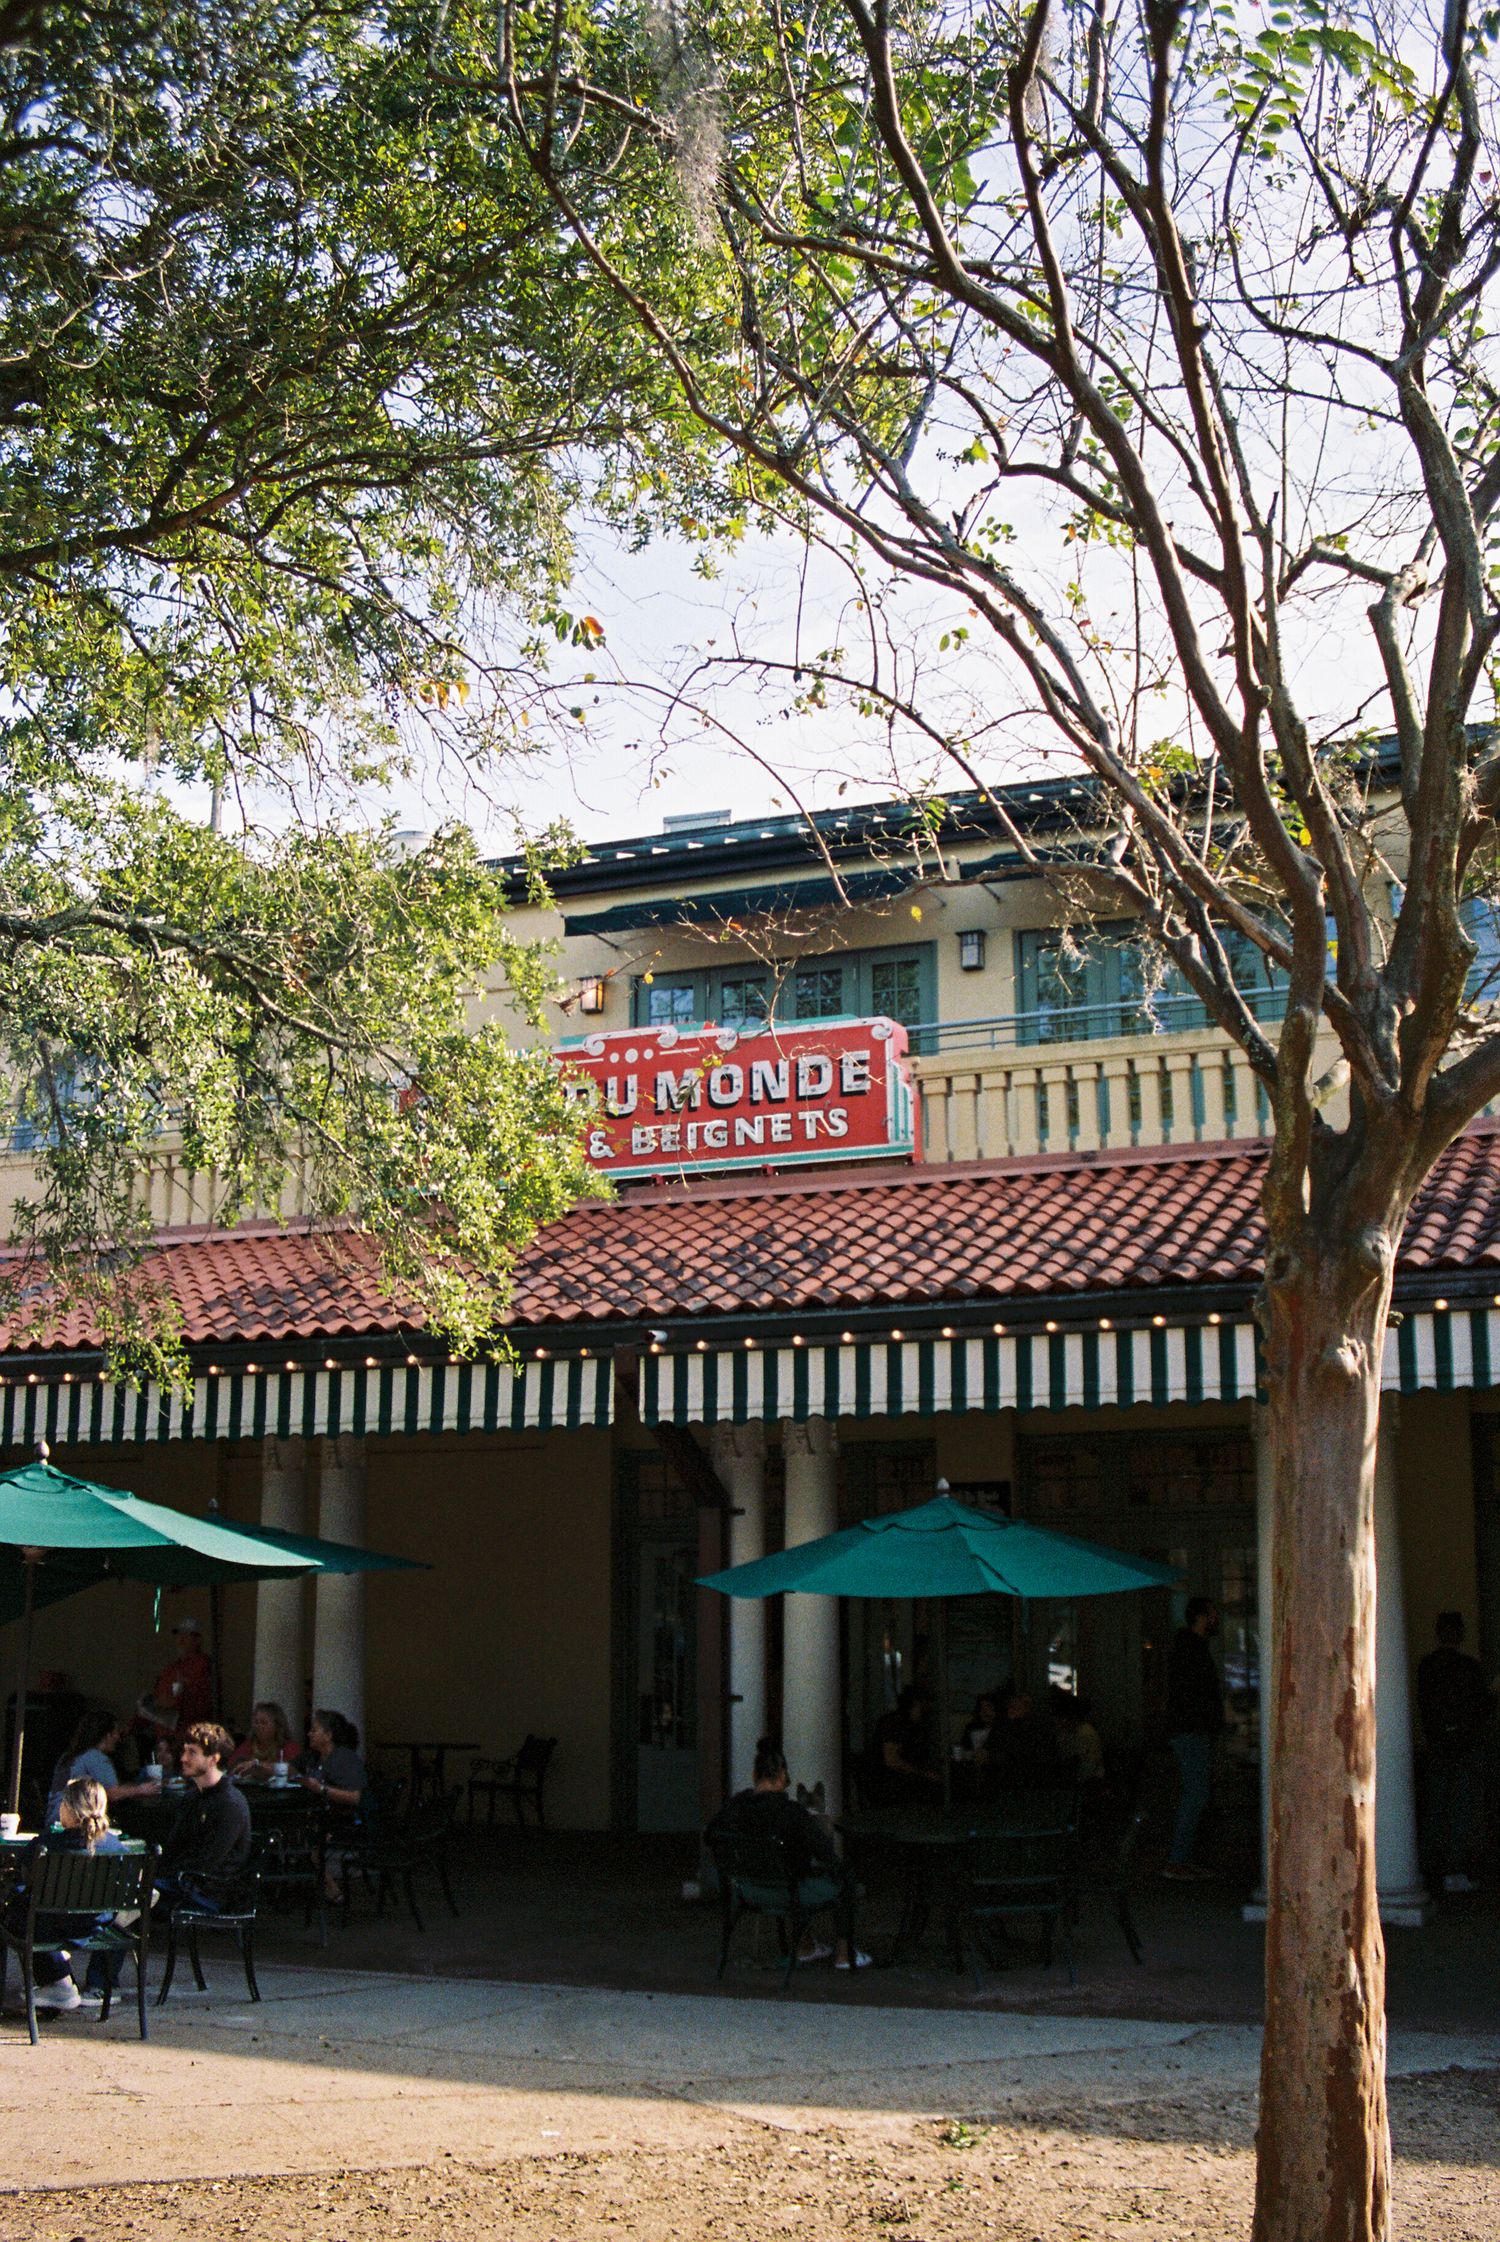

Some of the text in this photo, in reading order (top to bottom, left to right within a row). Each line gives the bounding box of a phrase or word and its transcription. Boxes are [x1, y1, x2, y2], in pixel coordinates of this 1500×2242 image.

[655, 1050, 871, 1113] MONDE
[589, 1108, 849, 1159] & BEIGNETS
